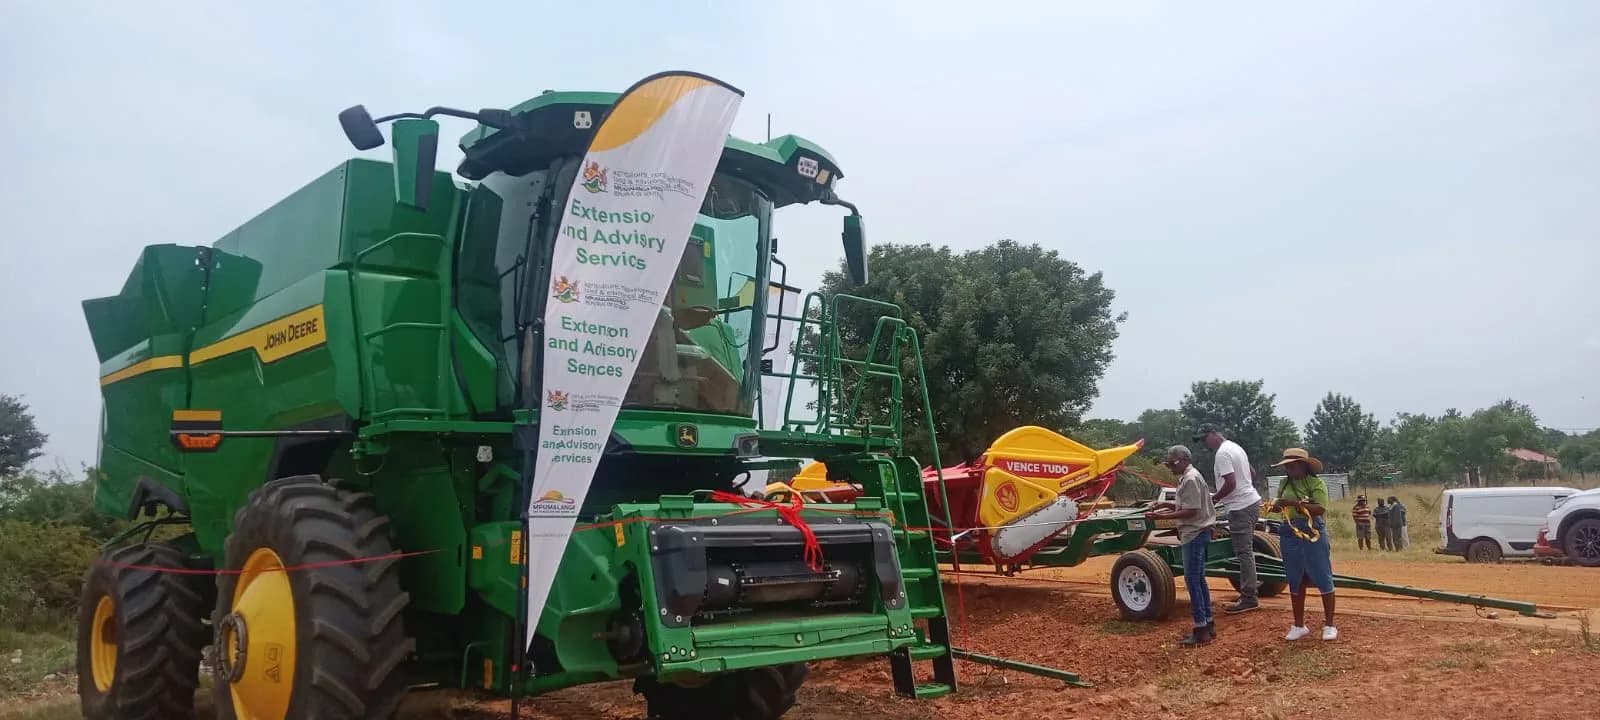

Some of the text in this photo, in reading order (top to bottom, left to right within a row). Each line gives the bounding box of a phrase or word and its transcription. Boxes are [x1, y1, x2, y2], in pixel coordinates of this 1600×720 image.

[562, 225, 587, 242] nd
[264, 318, 318, 351] JOHN DEERE
[548, 337, 578, 353] and
[551, 453, 593, 464] ervices
[1006, 461, 1069, 475] VENCE TUDO
